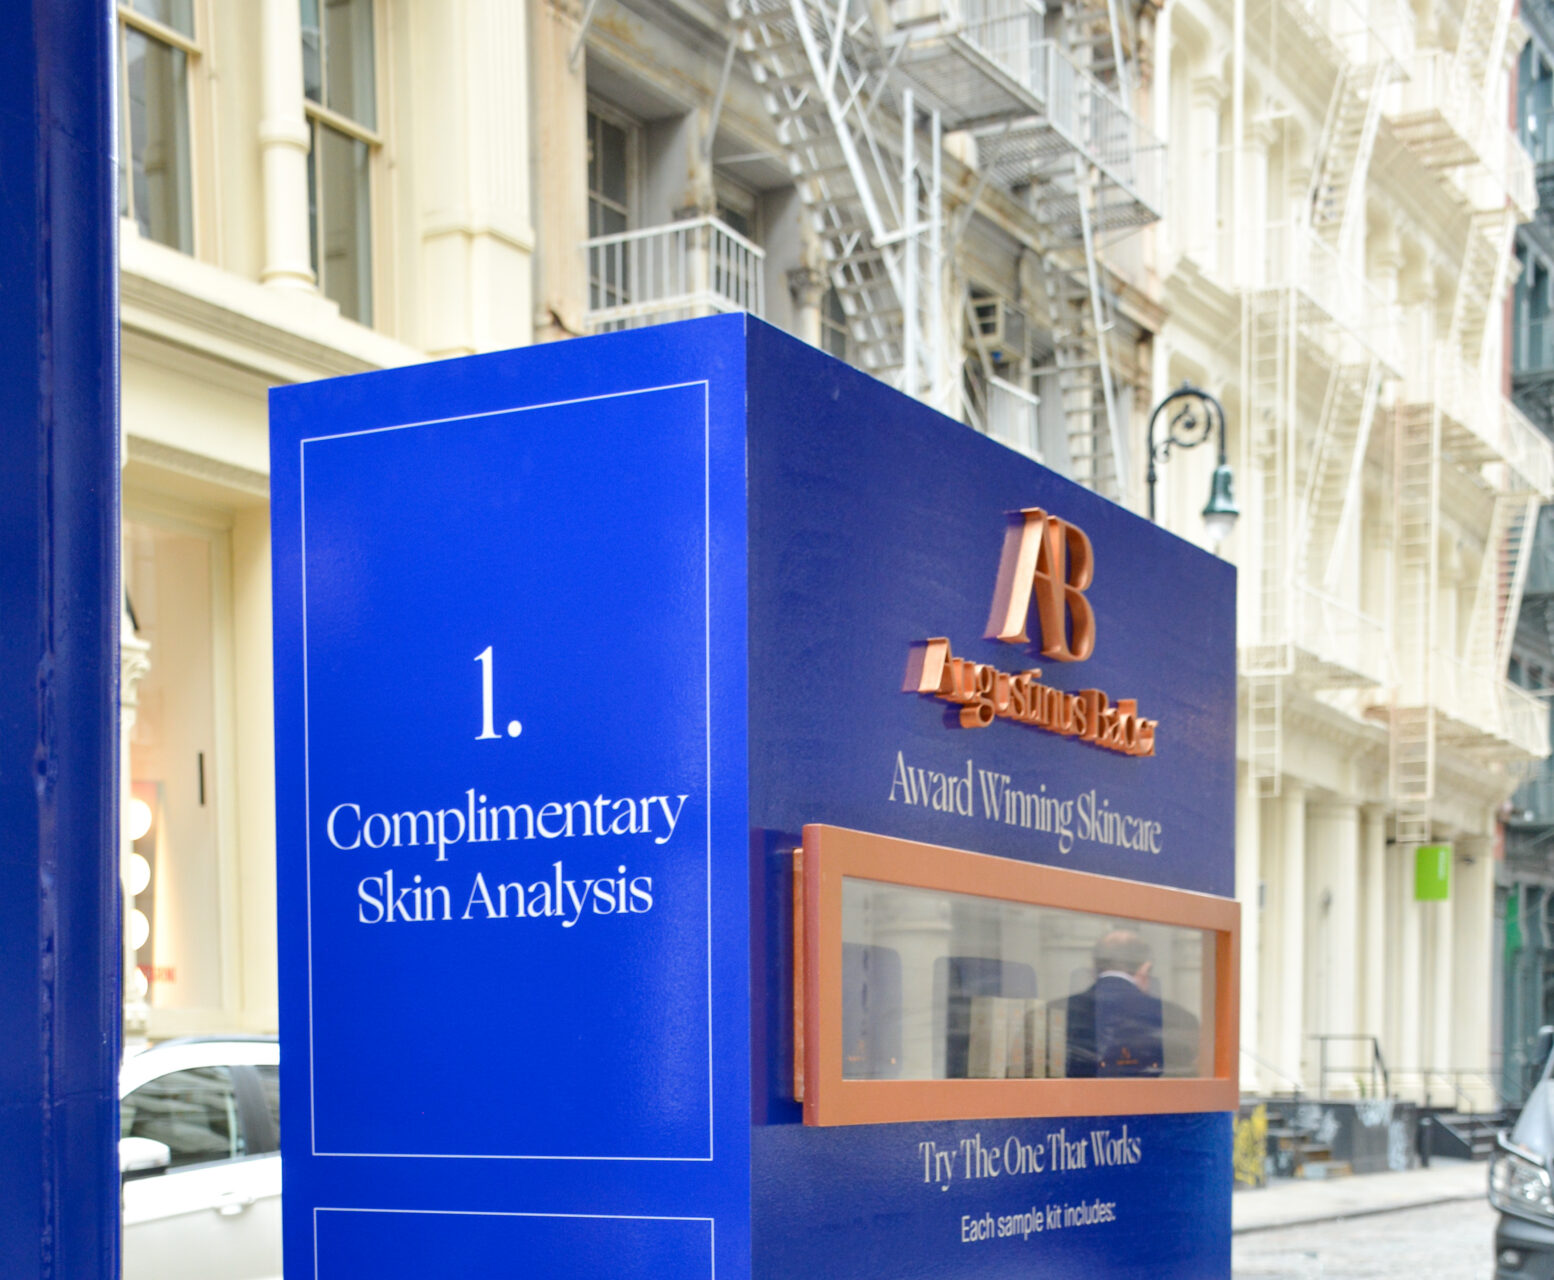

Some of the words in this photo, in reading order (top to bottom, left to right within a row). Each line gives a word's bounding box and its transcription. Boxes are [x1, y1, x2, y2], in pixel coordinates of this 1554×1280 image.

[996, 506, 1097, 662] AB
[474, 645, 523, 740] 1.
[326, 788, 690, 862] Complimentary
[888, 750, 974, 818] Award
[977, 769, 1074, 855] Winning
[1076, 789, 1163, 855] Skincare
[358, 869, 453, 924] Skin
[461, 861, 654, 928] Analysis
[918, 1140, 957, 1192] Try
[960, 1132, 1001, 1180] The
[1003, 1135, 1046, 1177] One
[1047, 1127, 1089, 1172] That
[1089, 1124, 1142, 1168] Works
[960, 1212, 996, 1243] Each
[996, 1206, 1044, 1241] sample
[1045, 1204, 1062, 1230] kit
[1063, 1198, 1117, 1228] includes:
